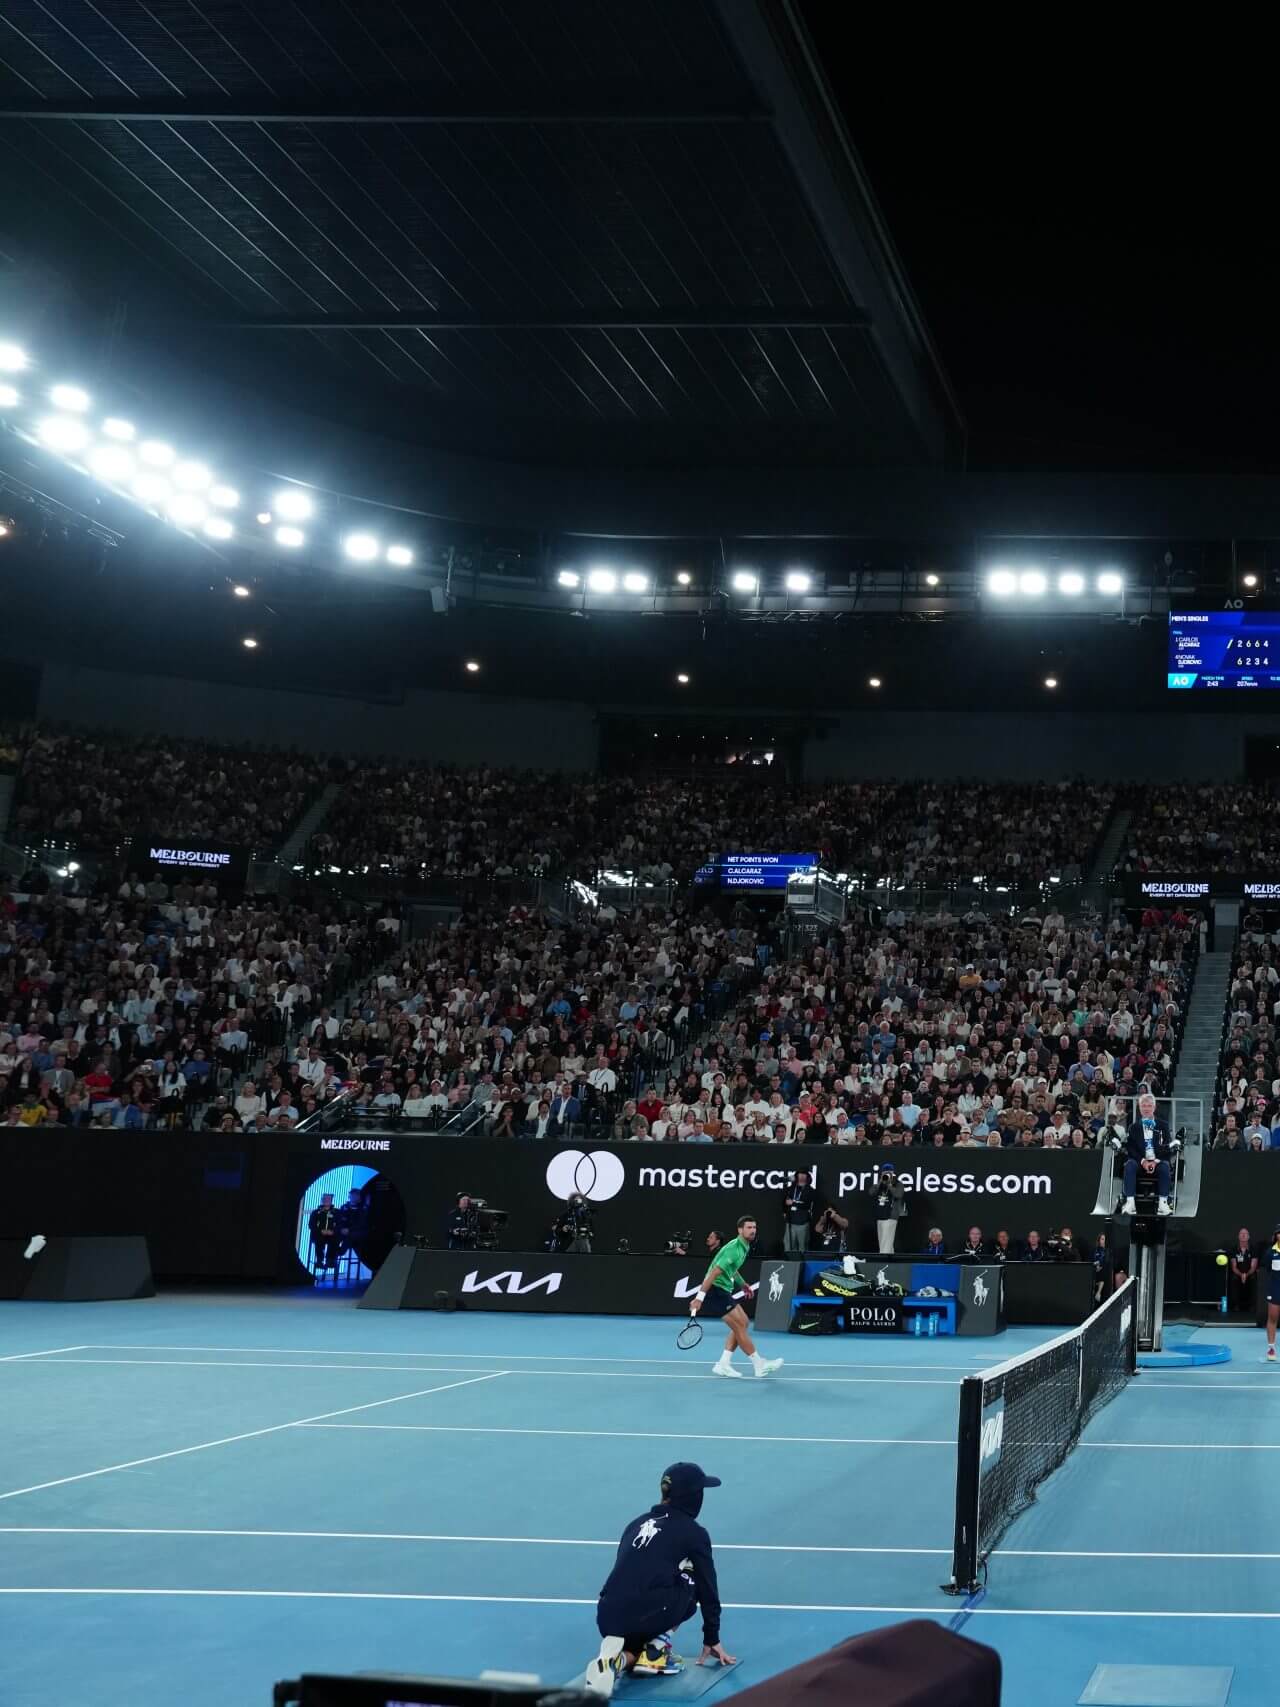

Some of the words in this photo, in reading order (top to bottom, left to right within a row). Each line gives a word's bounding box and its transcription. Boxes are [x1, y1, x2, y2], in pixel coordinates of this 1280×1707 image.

[1237, 640, 1243, 648] 2
[1246, 640, 1251, 648] 6
[1254, 640, 1260, 648] 6
[1263, 640, 1269, 648] 4
[1237, 657, 1243, 665] 6
[1245, 657, 1251, 666] 2
[1254, 657, 1260, 666] 3
[1263, 657, 1269, 665] 4
[150, 848, 231, 864] MELBOURNE
[1142, 883, 1209, 893] MELBOURNE
[320, 1138, 391, 1151] MELBOURNE
[839, 1164, 1052, 1198] prieless.com
[461, 1270, 563, 1295] KIA
[850, 1307, 896, 1322] POLO
